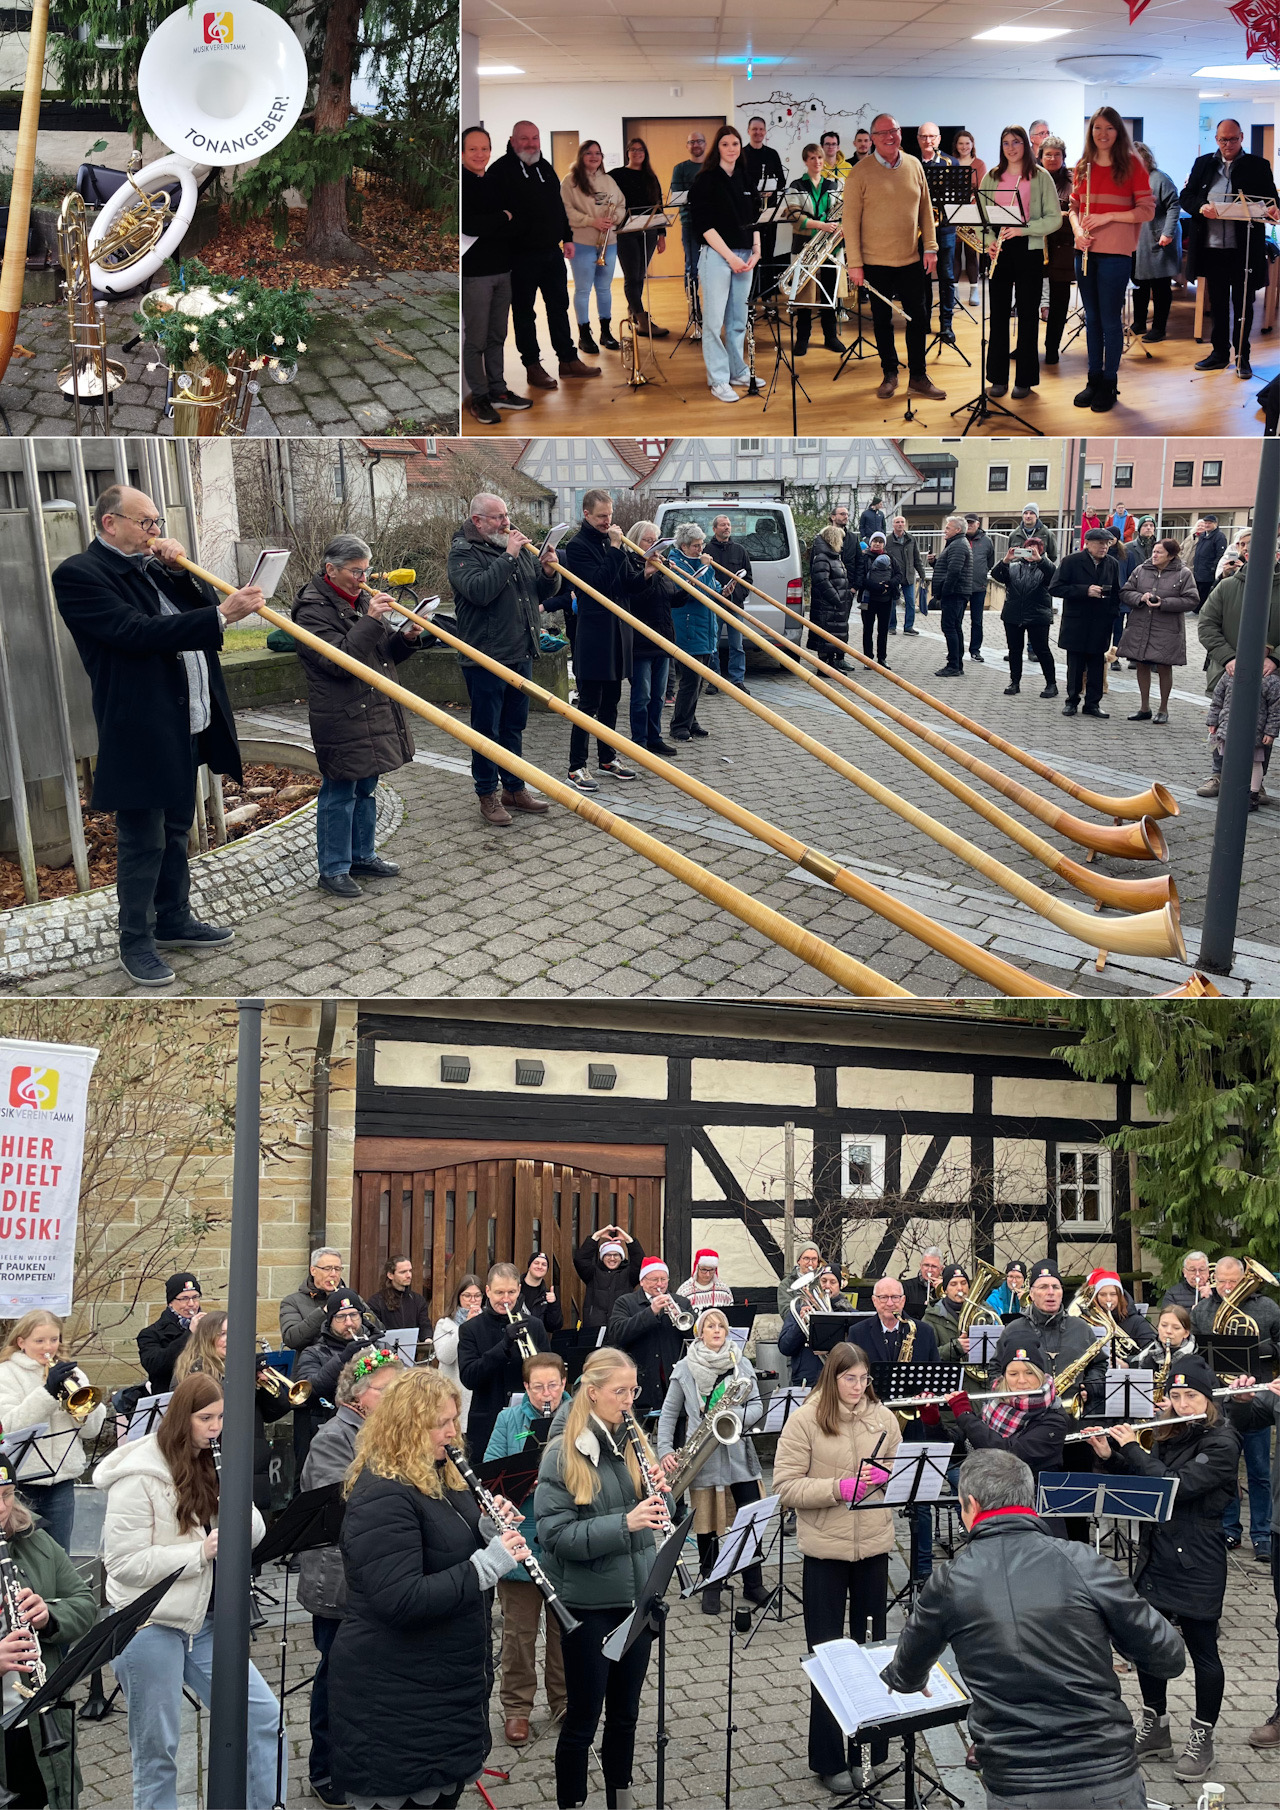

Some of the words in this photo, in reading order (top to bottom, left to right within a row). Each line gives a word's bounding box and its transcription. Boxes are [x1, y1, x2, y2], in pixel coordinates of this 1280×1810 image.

[184, 96, 290, 153] TONANGEBER!
[1, 1135, 54, 1160] HIER
[2, 1189, 41, 1213] DIE
[6, 1262, 46, 1271] PAUKEN
